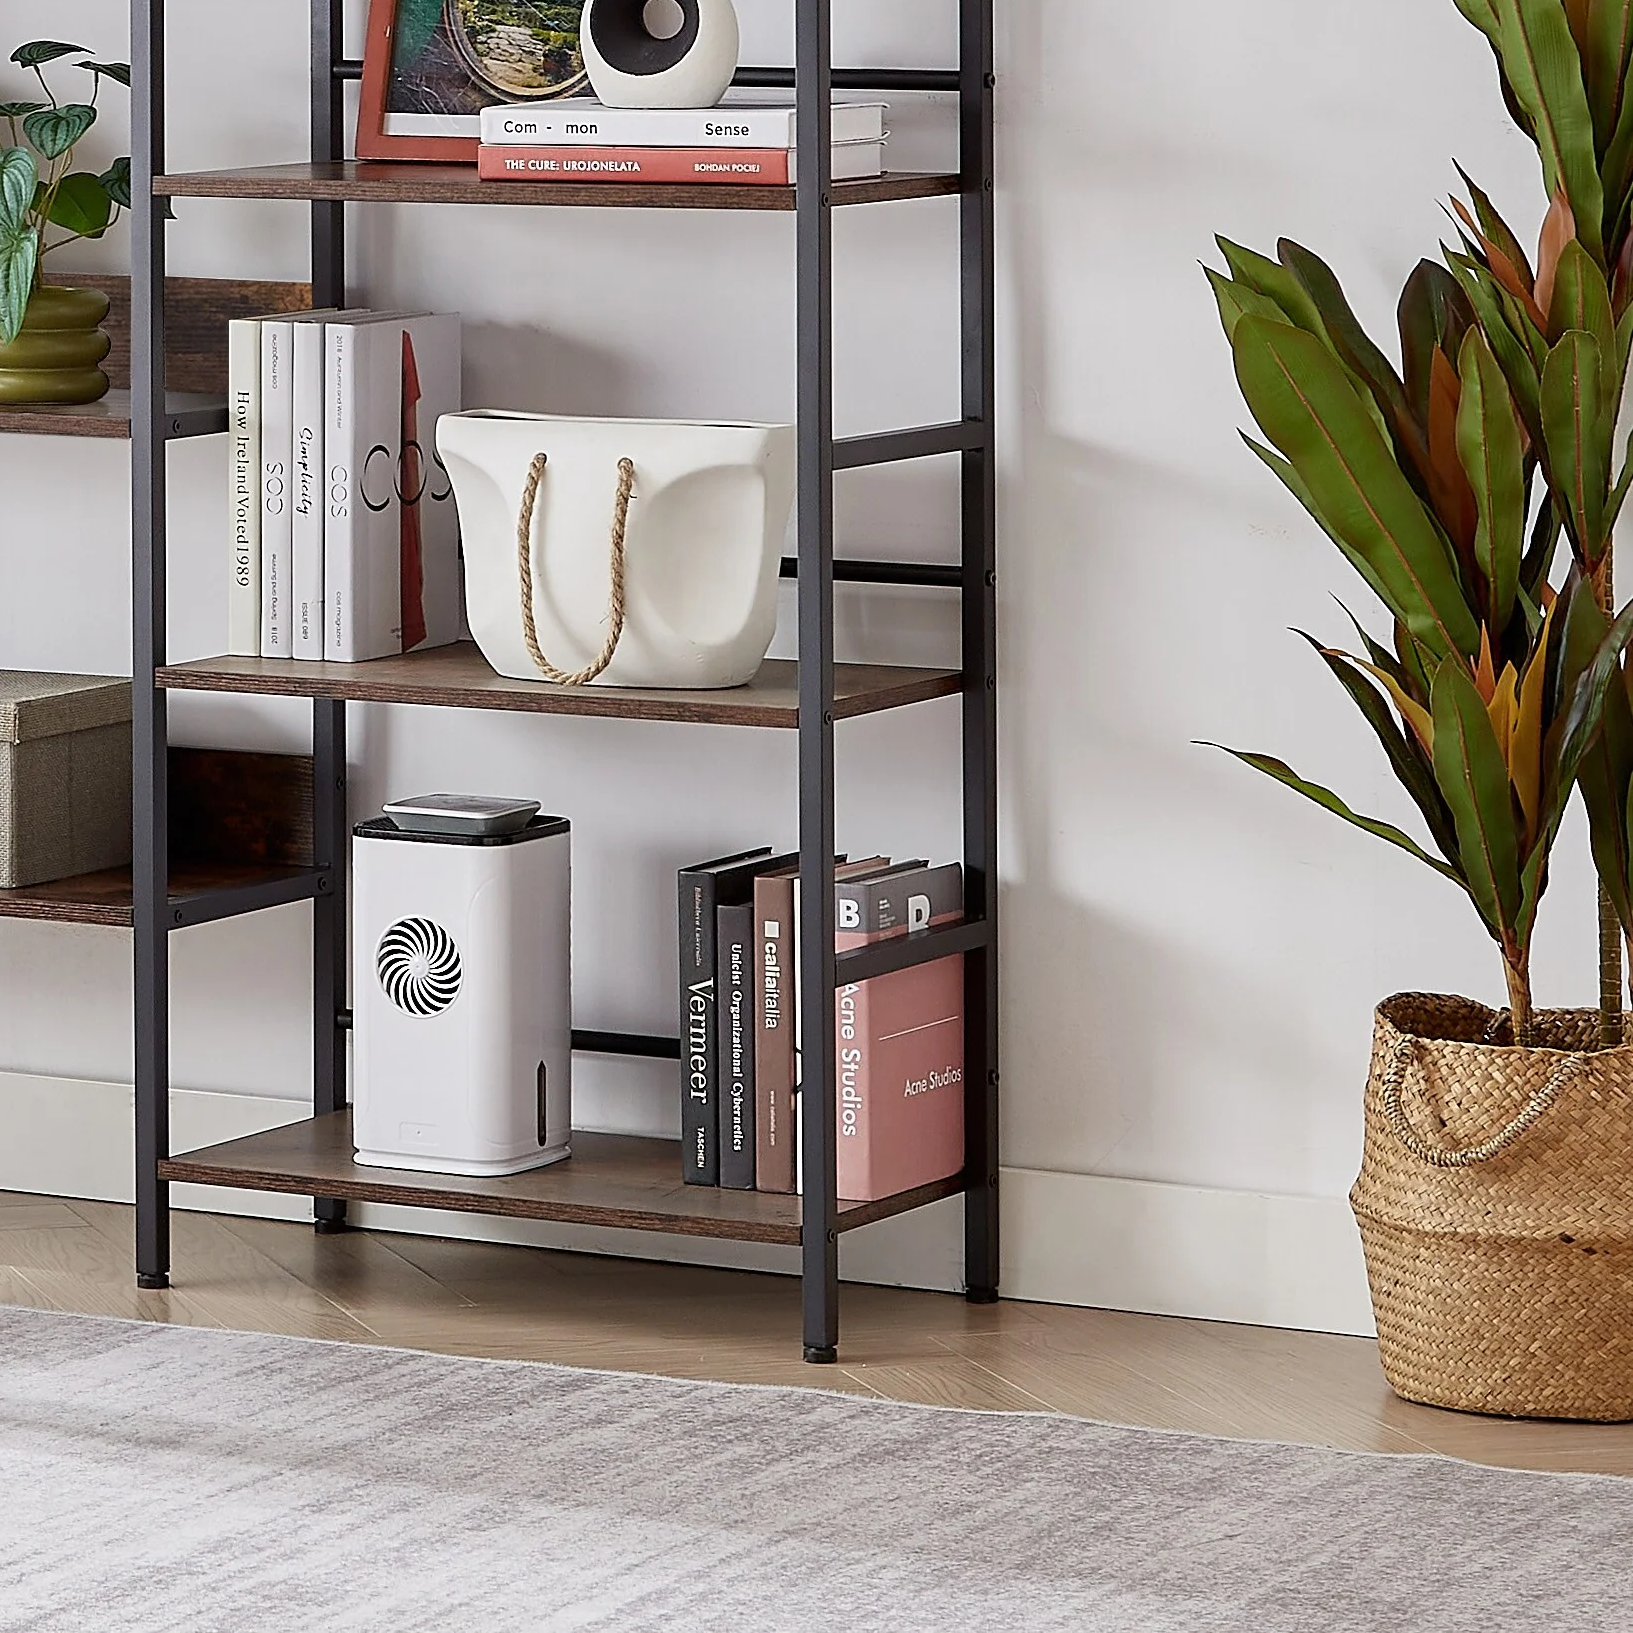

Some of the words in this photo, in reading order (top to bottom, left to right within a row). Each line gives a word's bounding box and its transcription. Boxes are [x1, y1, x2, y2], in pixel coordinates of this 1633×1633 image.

[503, 120, 537, 134] Com
[566, 123, 598, 134] mon
[705, 122, 750, 136] Sense
[504, 159, 526, 170] THE
[528, 159, 560, 171] CURE:
[694, 163, 731, 172] BOHDAN
[236, 391, 250, 430] How
[266, 462, 284, 515] COS
[296, 427, 313, 518] Simplicity
[331, 465, 348, 518] COS
[839, 898, 860, 928] B
[764, 942, 781, 1029] caliaitalia
[840, 983, 860, 1040] Acne
[687, 976, 714, 1105] Vermeer
[730, 990, 744, 1078] Organizational
[841, 1048, 863, 1137] Studios
[903, 1078, 927, 1098] Acne
[929, 1066, 962, 1090] Studios
[730, 1082, 744, 1151] Cybernetics
[697, 1126, 705, 1168] TASCHEN
